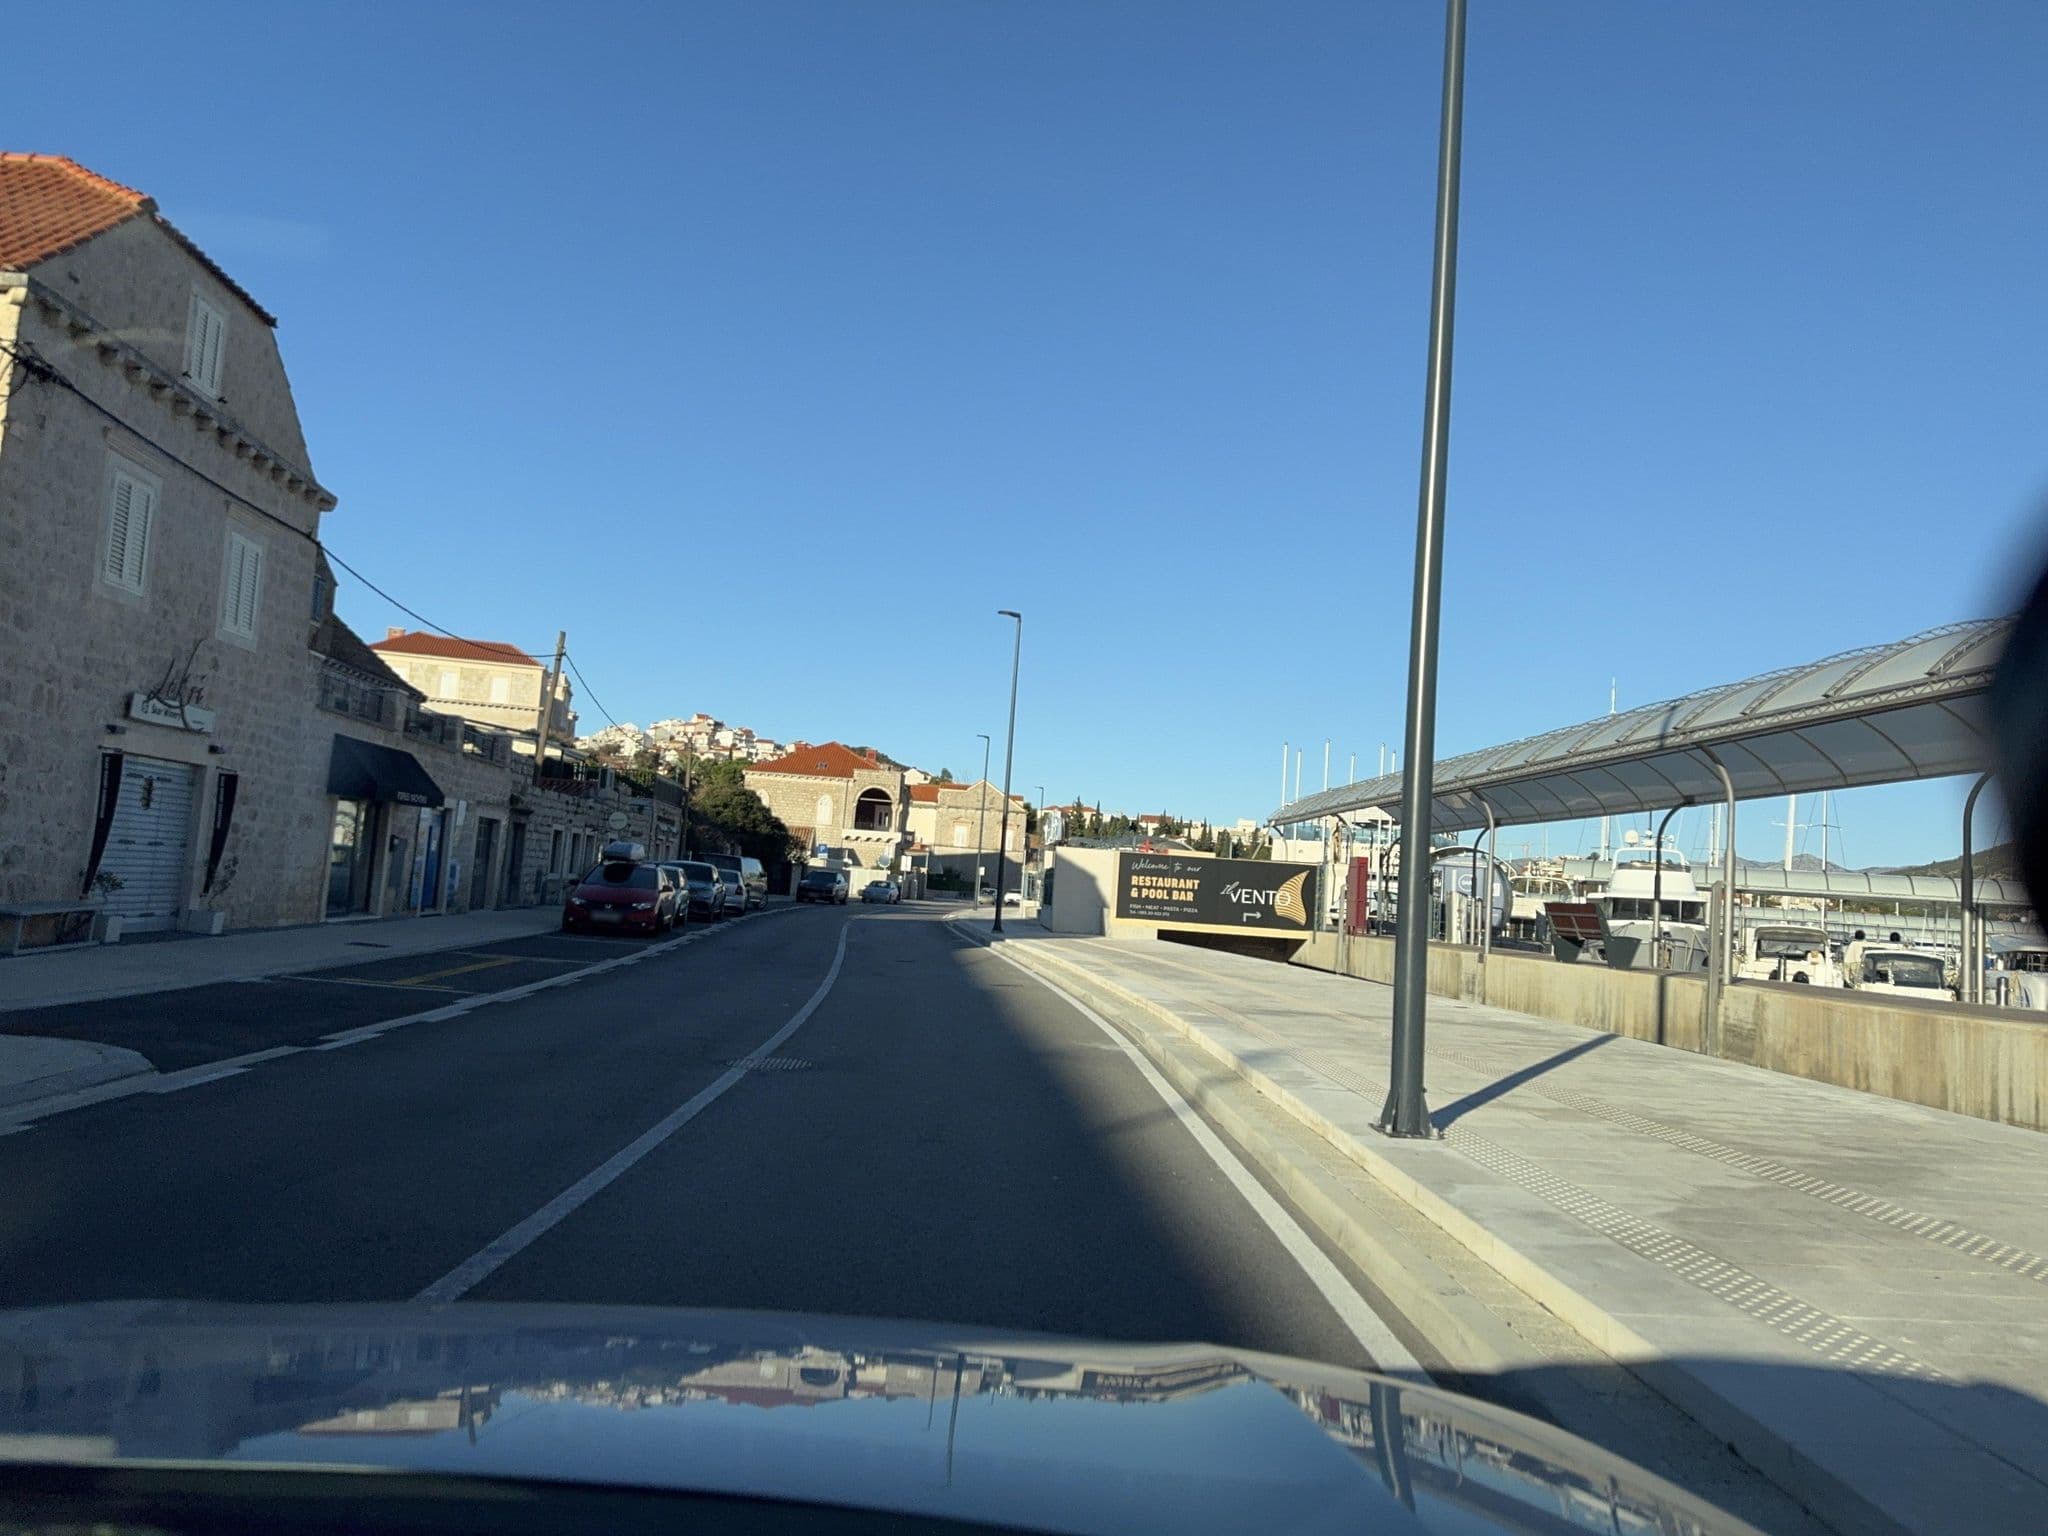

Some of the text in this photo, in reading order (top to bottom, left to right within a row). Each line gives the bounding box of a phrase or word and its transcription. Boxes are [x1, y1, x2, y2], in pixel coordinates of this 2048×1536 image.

[1131, 858, 1169, 871] Welcome
[1173, 862, 1183, 873] to
[1131, 875, 1200, 890] RESTAURANT
[1130, 887, 1194, 902] & POOL BAR
[1230, 888, 1291, 906] VENTO
